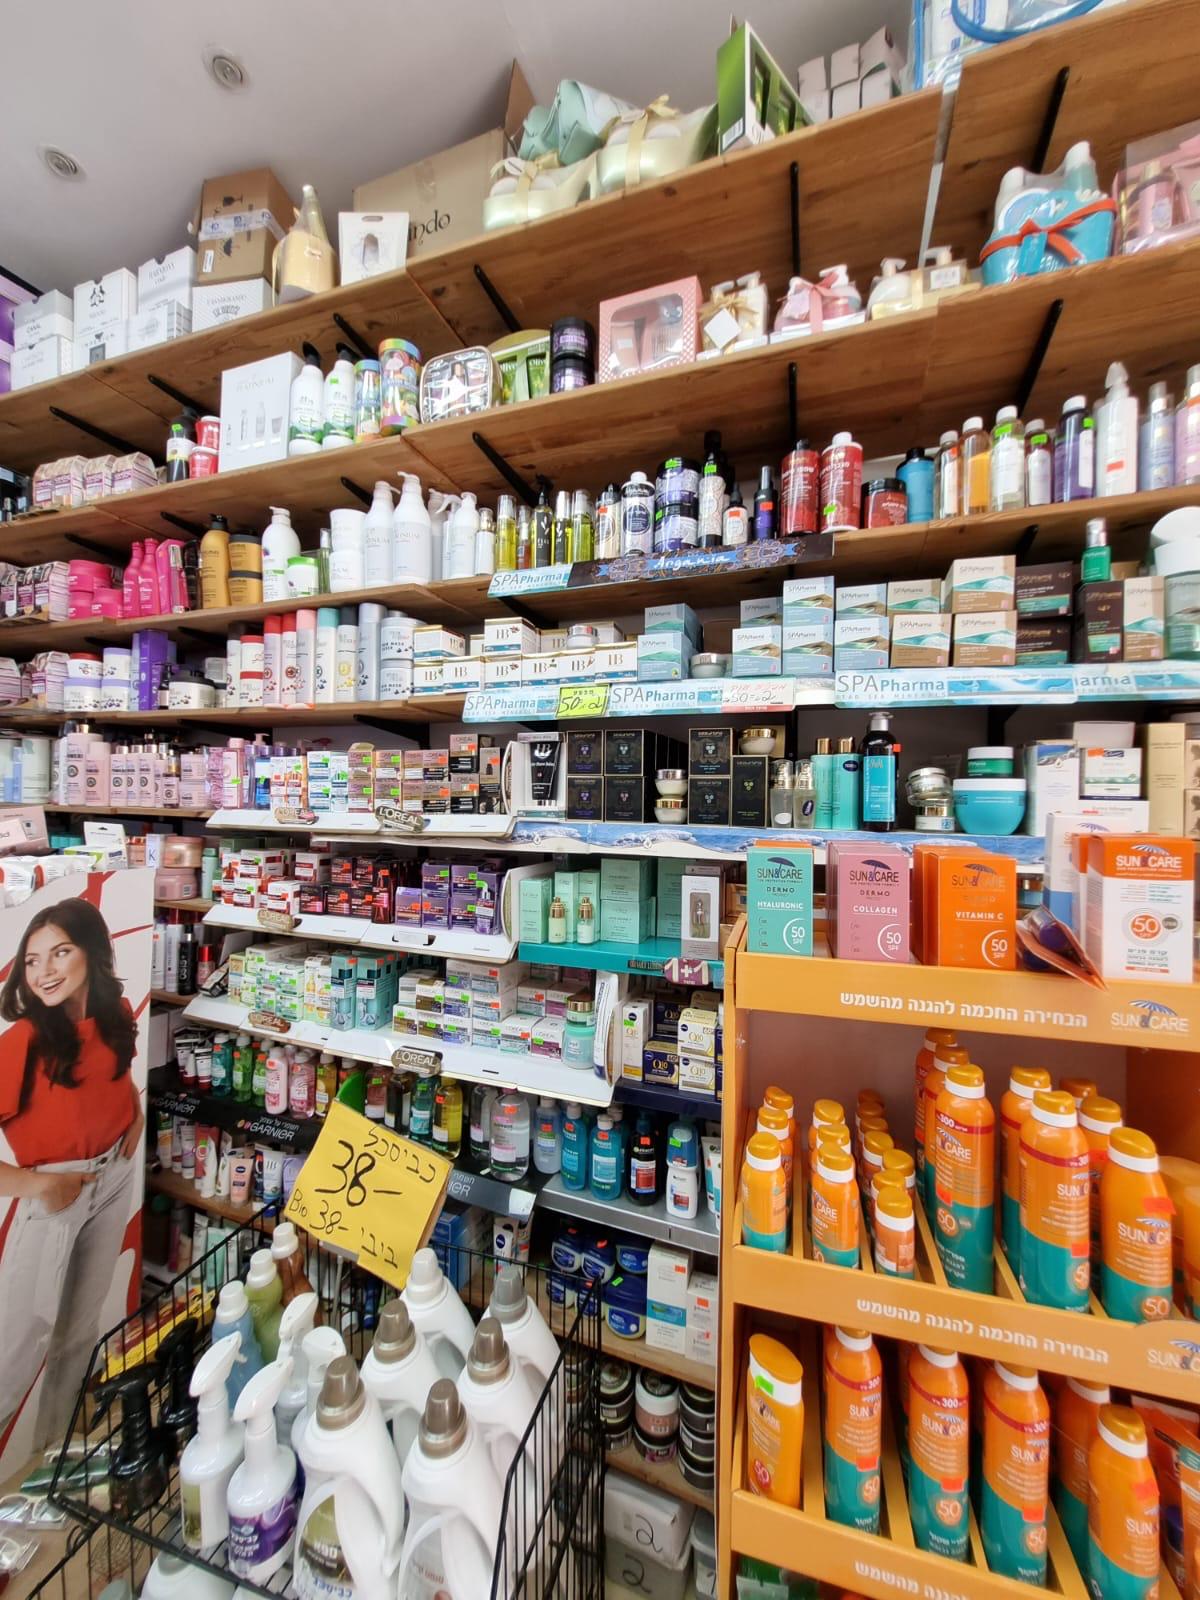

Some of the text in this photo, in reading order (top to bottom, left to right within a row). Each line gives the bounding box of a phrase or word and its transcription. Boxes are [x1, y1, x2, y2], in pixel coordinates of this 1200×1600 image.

[766, 886, 795, 894] DERMO
[860, 889, 890, 897] DERMO
[757, 901, 804, 909] HYALURONIC
[853, 905, 898, 914] COLLAGEN
[955, 911, 1004, 920] VITAMIN C
[791, 926, 805, 938] 50
[1133, 918, 1159, 933] 50
[886, 931, 901, 945] 50
[991, 939, 1008, 952] 50
[839, 991, 1088, 1028] הבחירה החכמה להגנה מהשמש
[250, 1122, 295, 1141] GARNIER
[937, 1209, 957, 1229] 50
[1143, 1297, 1169, 1315] 50
[856, 1298, 1110, 1364] הבחירה החכמה להגנה מהשמש
[938, 1498, 961, 1517] 50
[854, 1560, 919, 1593] מהשמש
